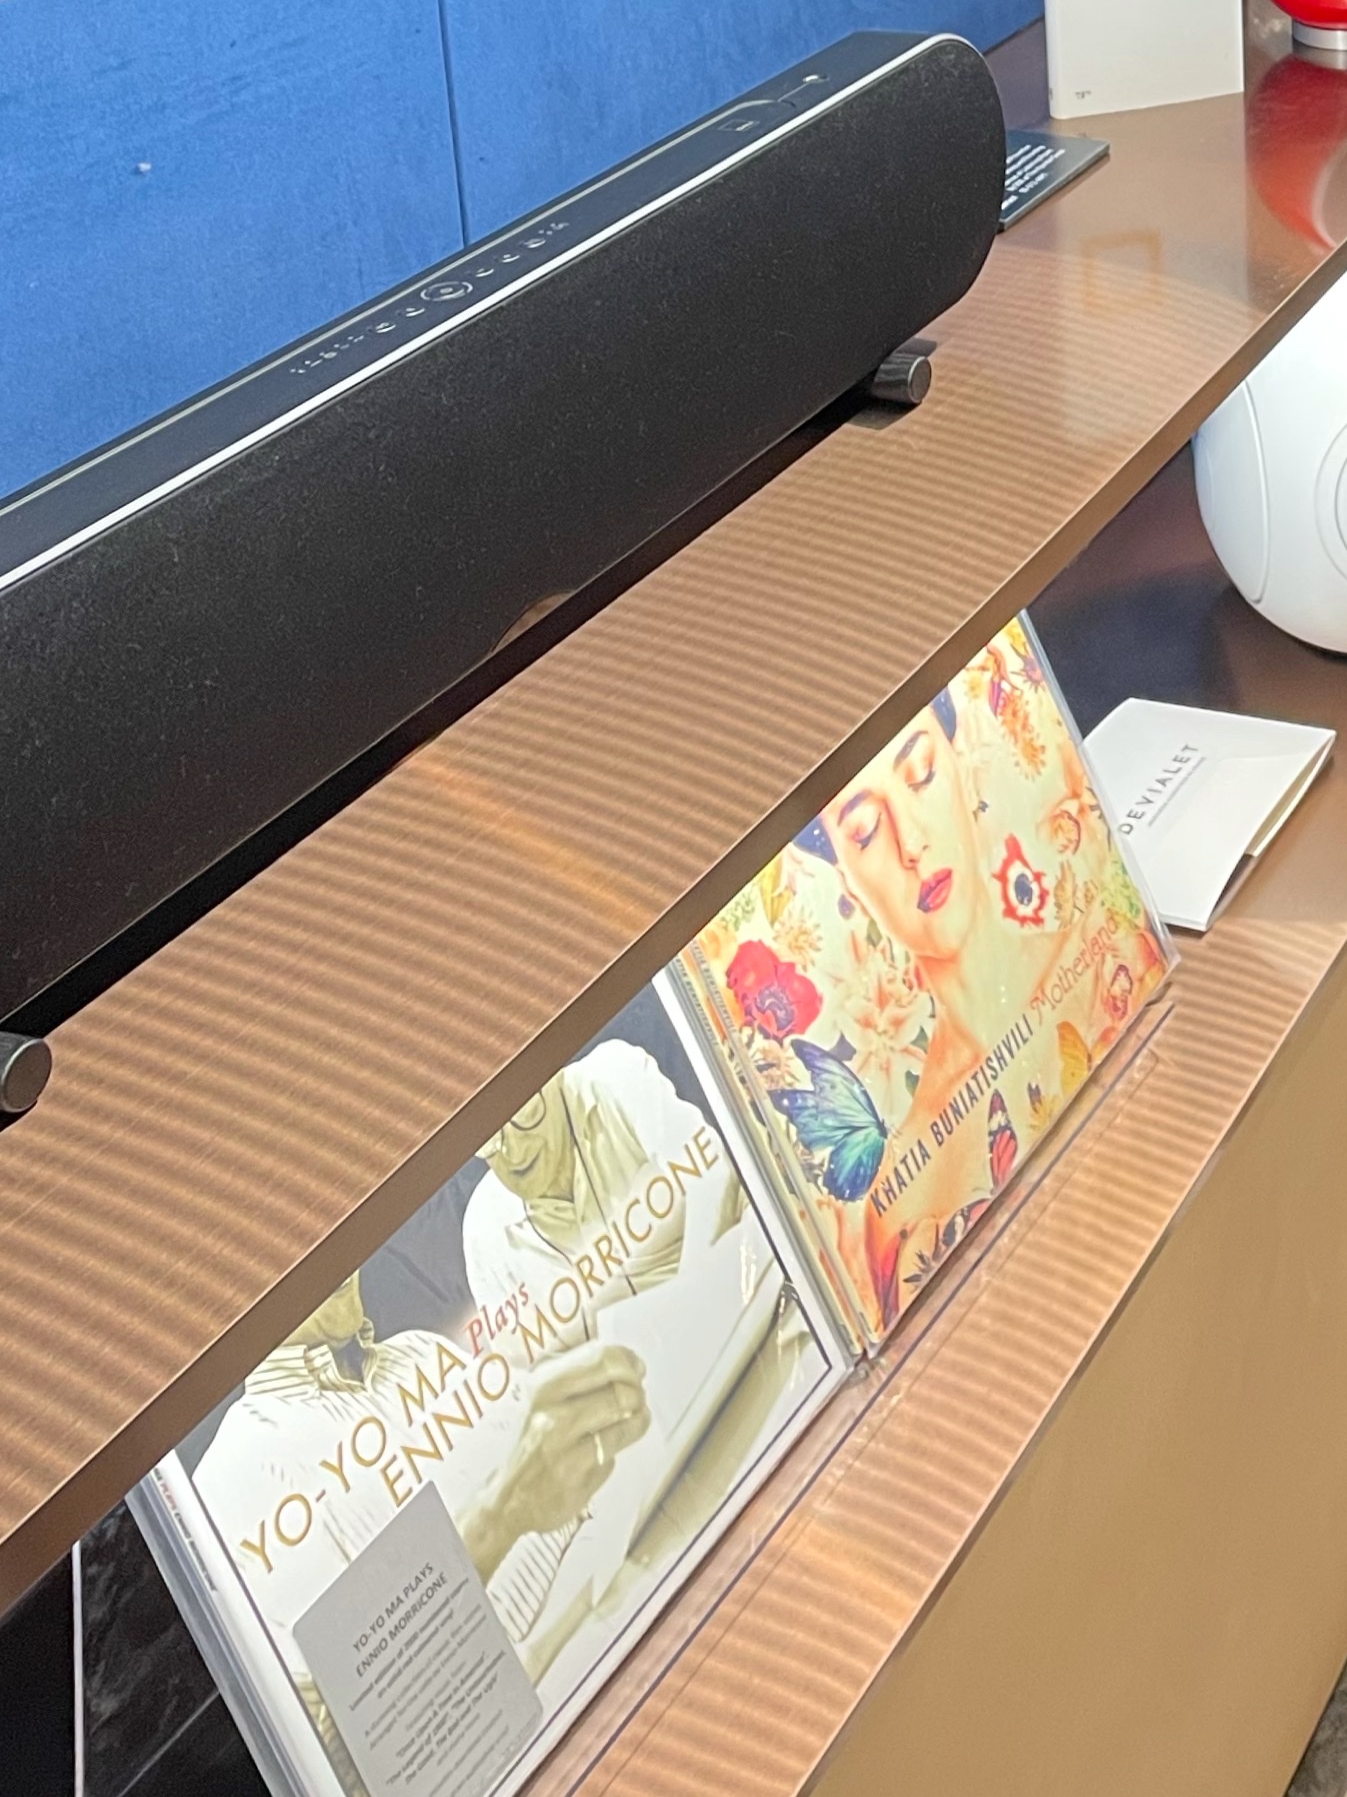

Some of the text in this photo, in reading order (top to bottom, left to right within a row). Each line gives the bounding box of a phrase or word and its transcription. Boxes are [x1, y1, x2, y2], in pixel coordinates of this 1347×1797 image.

[1117, 744, 1198, 835] DEVIALET
[869, 915, 1119, 1217] KHATIA BUNIATISHVILI Motherland
[379, 1353, 511, 1508] ENNIO
[519, 1127, 719, 1364] MORRICONE
[240, 1415, 388, 1574] YO-YO
[396, 1343, 467, 1427] MA
[463, 1281, 530, 1358] Plays
[353, 1562, 435, 1653] YO-YO MA PLAYS
[355, 1638, 388, 1678] ENNIO
[388, 1572, 449, 1641] MORRICONE
